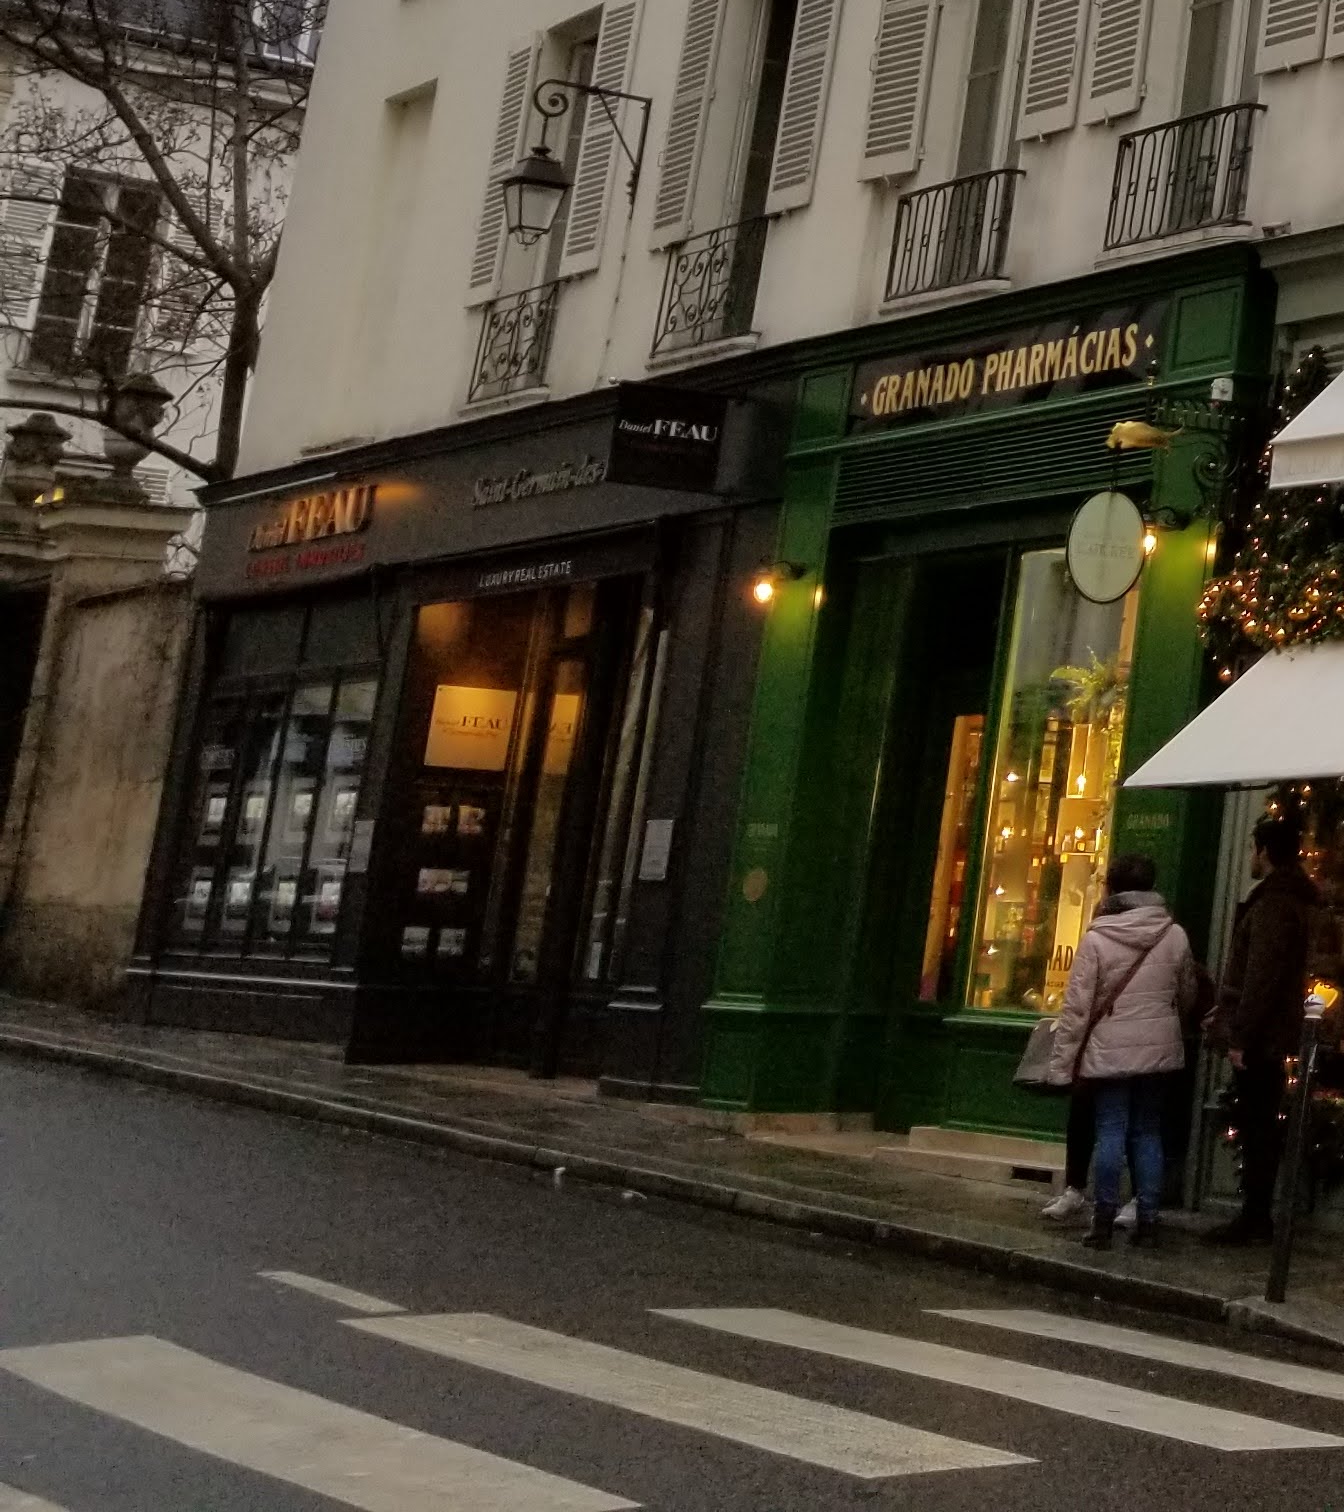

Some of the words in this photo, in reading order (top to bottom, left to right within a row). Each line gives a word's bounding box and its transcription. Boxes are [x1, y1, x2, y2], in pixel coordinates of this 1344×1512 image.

[872, 357, 975, 416] GRANADO
[981, 323, 1139, 395] PHARMÁCIAS
[653, 419, 718, 442] FEAU
[287, 484, 375, 544] FEAU
[537, 560, 572, 579] ESTATE
